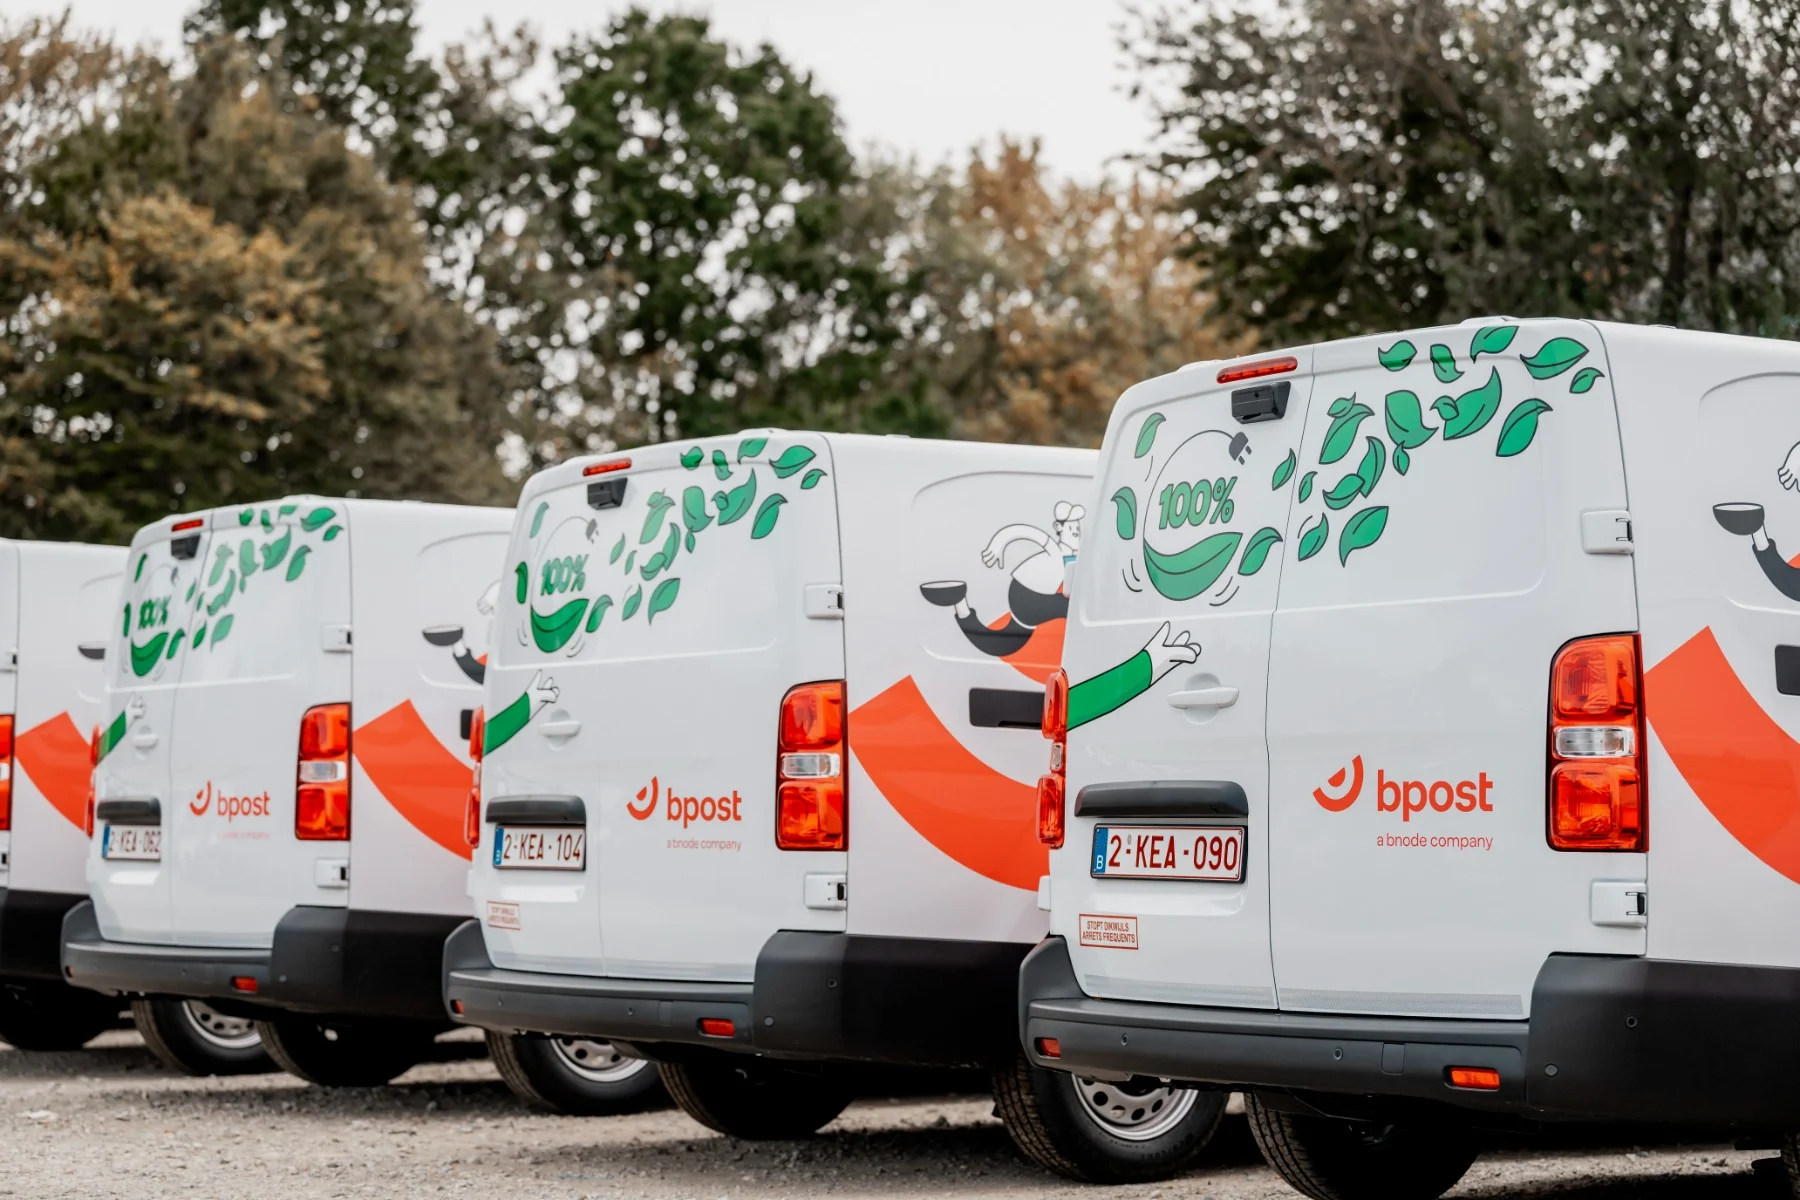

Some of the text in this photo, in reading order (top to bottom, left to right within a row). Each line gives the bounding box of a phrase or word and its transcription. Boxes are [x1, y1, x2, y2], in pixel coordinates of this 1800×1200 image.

[1158, 476, 1238, 530] 100%
[540, 553, 589, 597] 100%
[217, 789, 270, 823] bpost
[667, 787, 742, 829] bpost
[1377, 769, 1493, 822] bpost
[700, 840, 742, 852] company
[1377, 833, 1493, 851] a bnode company
[1096, 855, 1104, 869] B
[1082, 931, 1136, 943] ARRETS FREQUENTS
[1086, 920, 1103, 931] STOPT
